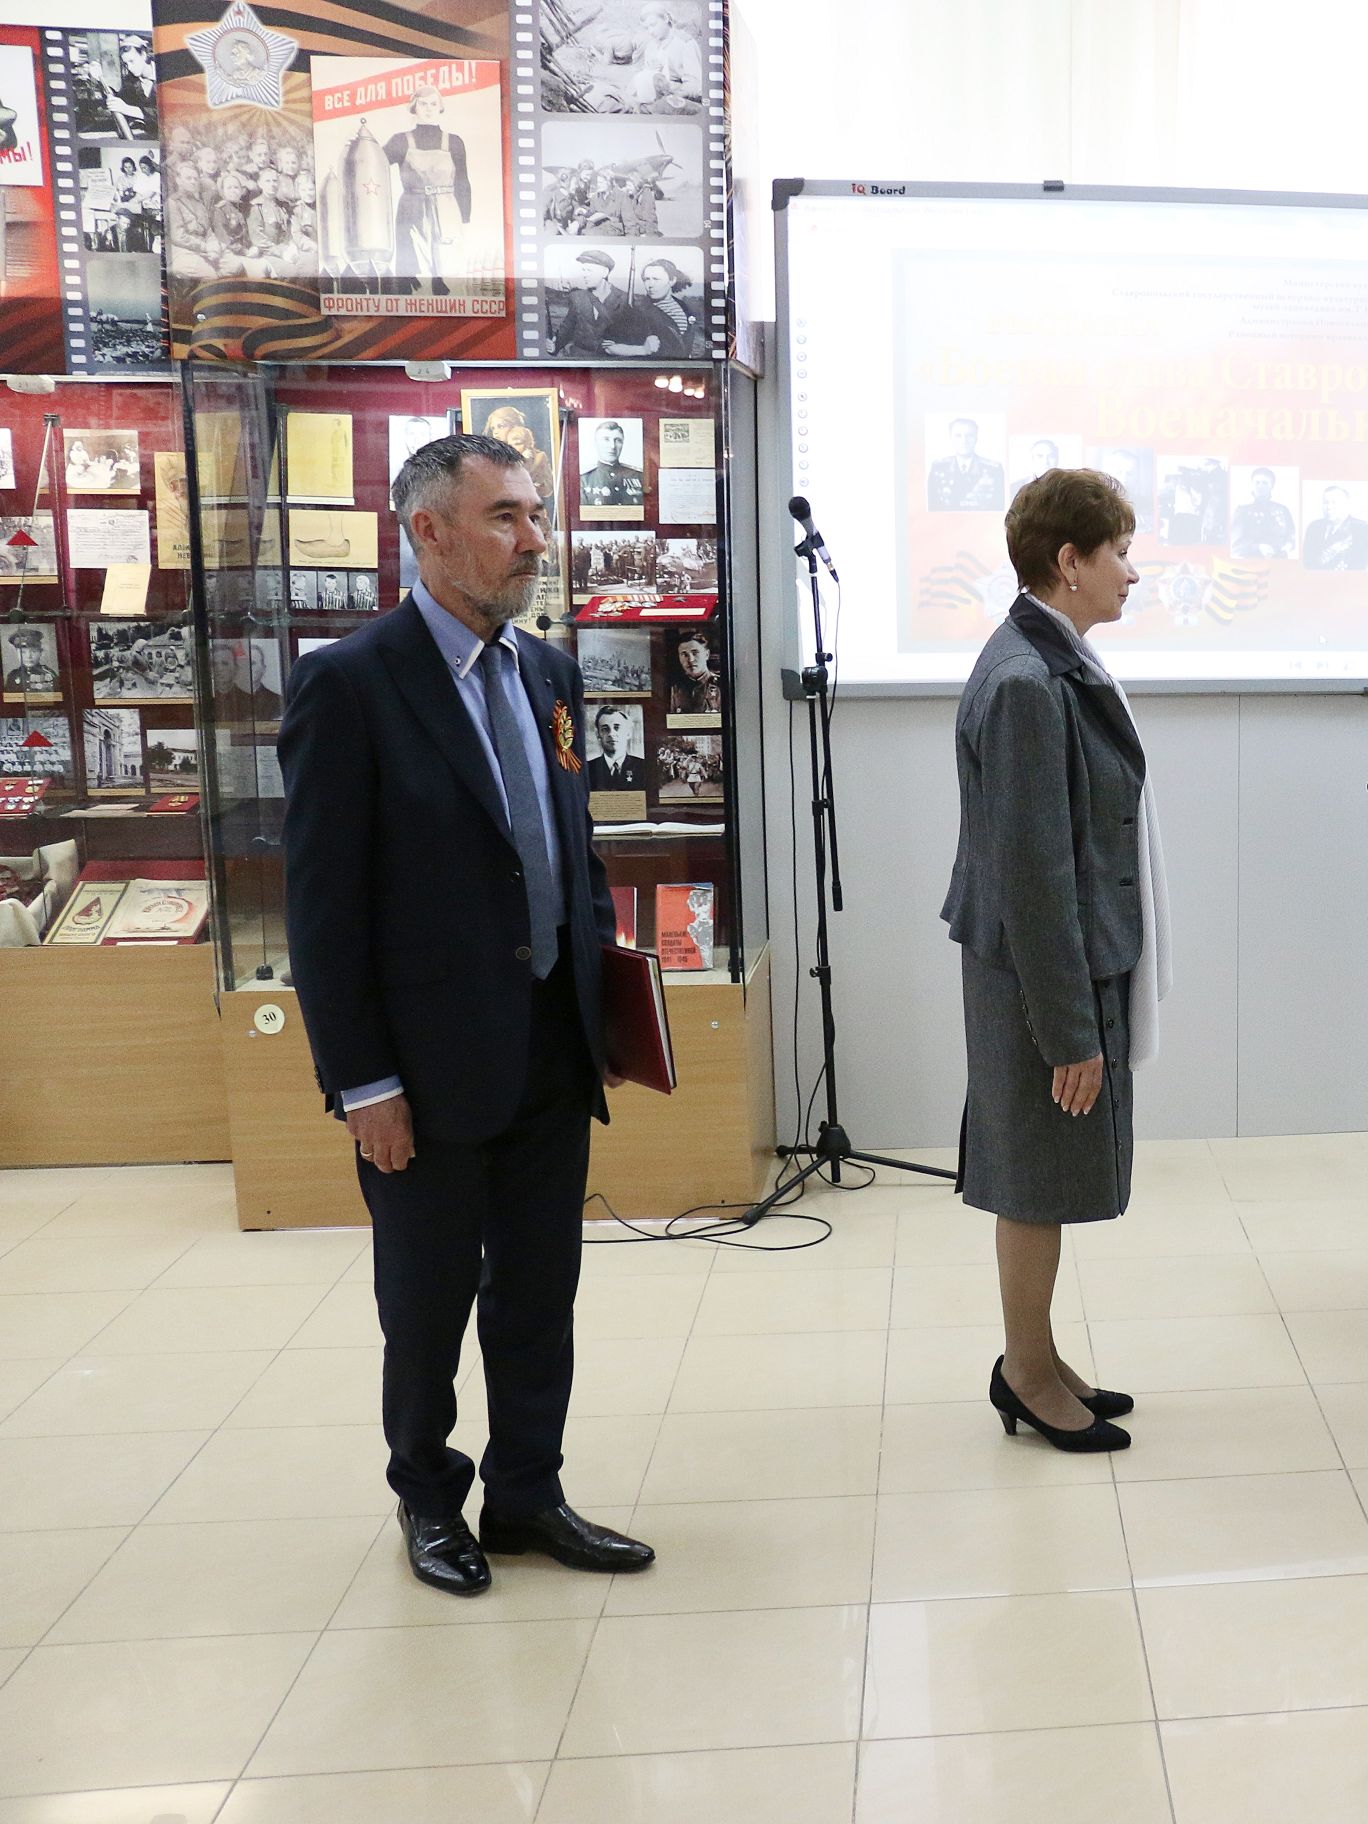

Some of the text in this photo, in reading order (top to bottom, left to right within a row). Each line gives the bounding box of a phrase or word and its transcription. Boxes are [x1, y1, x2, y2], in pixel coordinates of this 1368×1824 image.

[324, 60, 478, 110] ВСЕ ДЛЯ ПОБЕДЫ!
[871, 185, 906, 195] Board
[323, 297, 505, 316] ФРОНТУ ОТ ЖЕНЩИН СССР
[262, 1011, 277, 1025] 30
